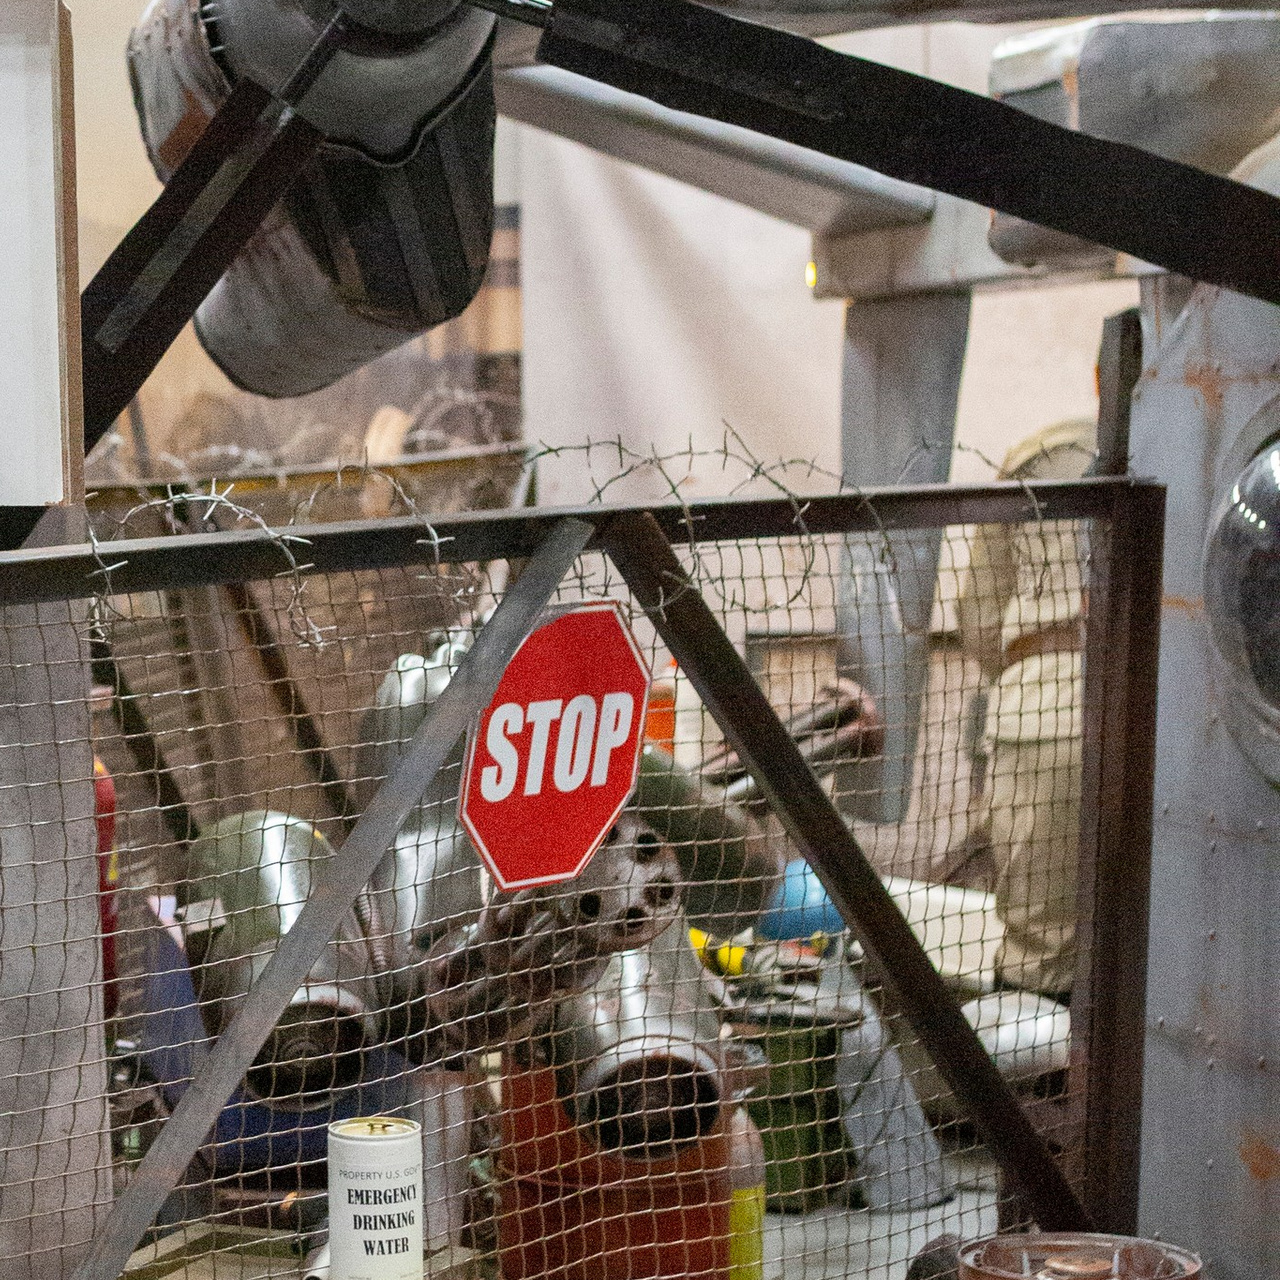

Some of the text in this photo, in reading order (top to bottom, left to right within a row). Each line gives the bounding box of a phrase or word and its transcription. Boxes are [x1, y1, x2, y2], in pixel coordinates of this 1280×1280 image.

[480, 691, 634, 802] STOP
[339, 1169, 383, 1180] PROPERTY
[347, 1184, 417, 1205] EMERGENCY
[353, 1210, 415, 1231] DRINKING
[363, 1237, 410, 1256] WATER
